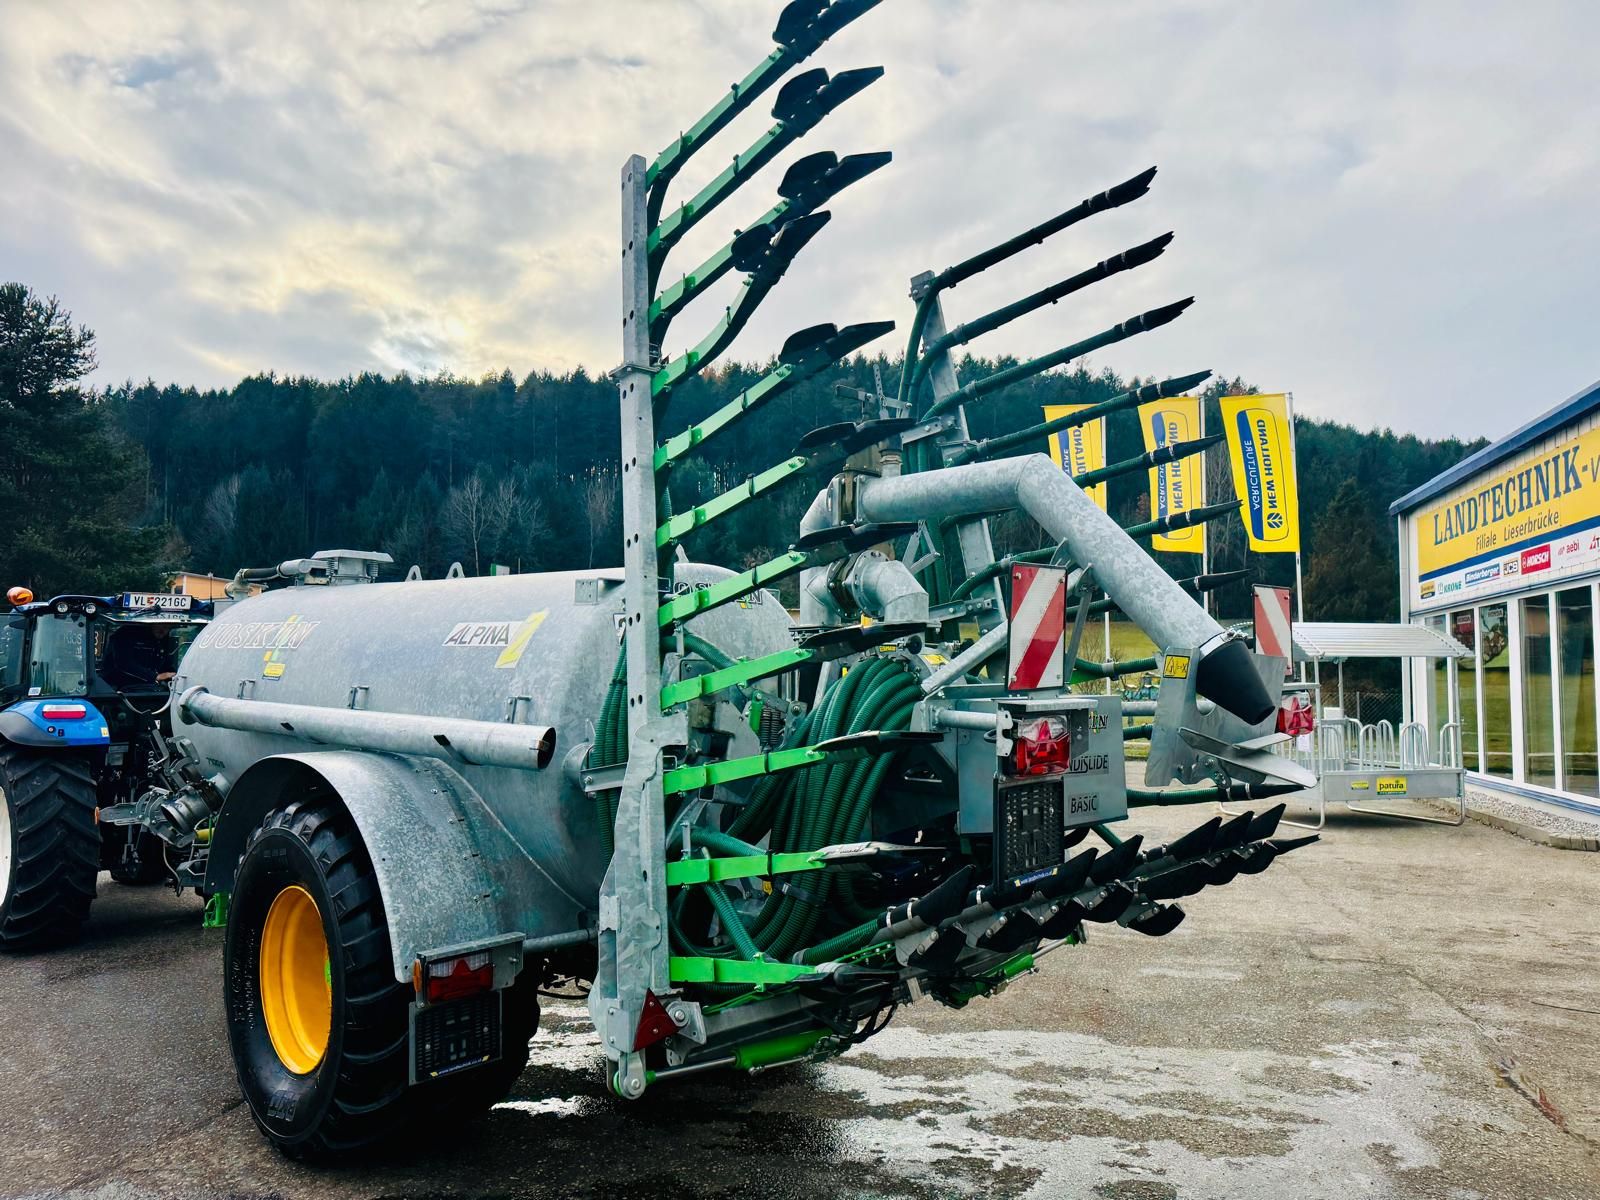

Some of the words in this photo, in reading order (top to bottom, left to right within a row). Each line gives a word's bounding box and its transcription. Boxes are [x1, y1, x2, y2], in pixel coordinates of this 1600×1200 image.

[1475, 530, 1497, 551] Filiale
[1503, 509, 1560, 542] Lieserbrücke
[1566, 539, 1580, 554] aebi
[1504, 560, 1518, 574] JCB
[1444, 581, 1462, 593] KRONE
[134, 596, 146, 606] VL
[154, 596, 187, 607] 221GC
[198, 620, 321, 649] JOSKIN
[444, 623, 510, 645] ALPINA
[1379, 783, 1404, 791] patura
[1070, 795, 1097, 814] BASIC
